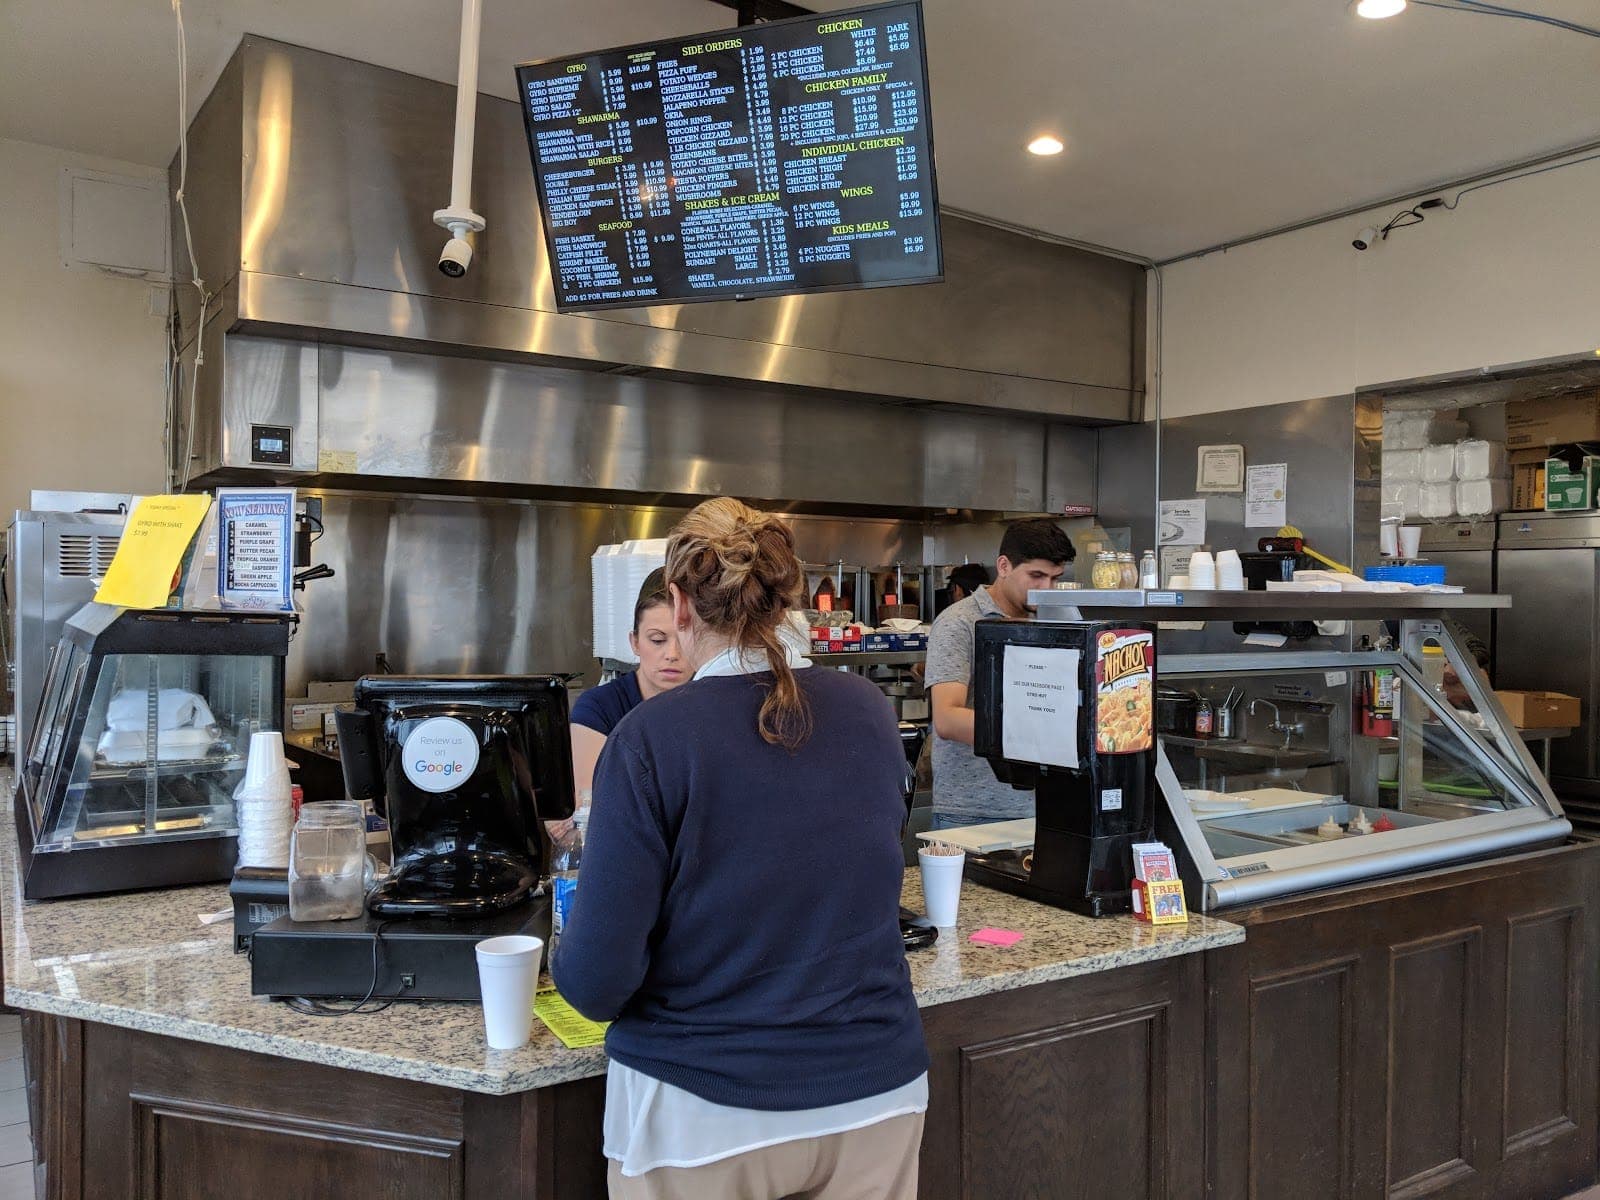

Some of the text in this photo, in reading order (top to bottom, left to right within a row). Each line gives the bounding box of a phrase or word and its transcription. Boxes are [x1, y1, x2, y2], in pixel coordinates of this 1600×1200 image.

[817, 18, 863, 34] CHICKEN
[850, 22, 908, 39] WHITE DARK
[682, 38, 742, 56] SIDE ORDERS
[770, 45, 823, 60] 2 PC CHICKEN
[566, 62, 587, 74] GYRO
[656, 59, 678, 69] FRIES
[771, 54, 824, 69] 3 PC CHICKEN
[657, 65, 698, 78] PIZZA PUFF
[779, 68, 789, 77] PC
[790, 63, 824, 75] CHICKEN
[527, 74, 582, 89] GYRO SANDWICH
[658, 70, 717, 86] POTATO WEDGES
[804, 73, 887, 93] CHICKEN FAMILY
[528, 83, 579, 97] GYRO SUPREME
[661, 85, 734, 103] MOZZARELLA STICKS
[840, 87, 865, 95] CHICKEN
[885, 81, 908, 89] SPECIAL
[530, 92, 576, 105] GYRO BURGER
[531, 101, 572, 113] GYRO SALAD
[787, 105, 797, 113] PC
[798, 100, 832, 112] CHICKEN
[576, 111, 620, 124] SHAWARMA
[663, 110, 684, 119] OKRA
[664, 114, 712, 128] ONION RINGS
[788, 114, 798, 122] PC
[799, 109, 833, 120] CHICKEN
[666, 120, 732, 136] POPCORN CHICKEN
[789, 122, 799, 130] PC
[800, 118, 834, 129] CHICKEN
[536, 128, 573, 139] SHAWARMA
[667, 129, 730, 144] CHICKEN GIZZARD
[790, 131, 800, 139] PC
[801, 126, 835, 138] CHICKEN
[537, 134, 593, 148] SHAWARMA WITH
[801, 136, 904, 157] INDIVIDUAL CHICKEN
[587, 155, 622, 166] BURGERS
[670, 153, 748, 169] POTATO CHEESE BITES
[783, 154, 847, 168] CHICKEN BREAST
[784, 163, 843, 177] CHICKEN THIGH
[785, 173, 835, 185] CHICKEN LEG
[674, 179, 737, 193] CHICKEN FINGERS
[786, 180, 842, 193] CHICKEN STRIP
[840, 186, 873, 198] WINGS
[547, 193, 590, 204] ITALIAN BEEF
[548, 198, 614, 212] CHICKEN SANDWICH
[684, 191, 780, 210] SHAKES & ICE CREAM
[798, 203, 808, 211] PC
[810, 200, 835, 210] WINGS
[803, 211, 813, 219] PC
[815, 208, 840, 217] WINGS
[598, 220, 632, 231] SEAFOOD
[804, 219, 814, 227] PC
[816, 217, 841, 226] WINGS
[832, 220, 889, 234] KIDS MEALS
[815, 243, 849, 253] NUGGETS
[815, 251, 850, 261] NUGGETS
[735, 261, 758, 270] LARGE
[687, 273, 714, 282] SHAKES
[223, 503, 288, 518] NOW SERVING!
[1103, 641, 1147, 685] NACHOS
[420, 736, 463, 745] Review us
[415, 760, 462, 776] Google
[1152, 884, 1180, 895] FREE
